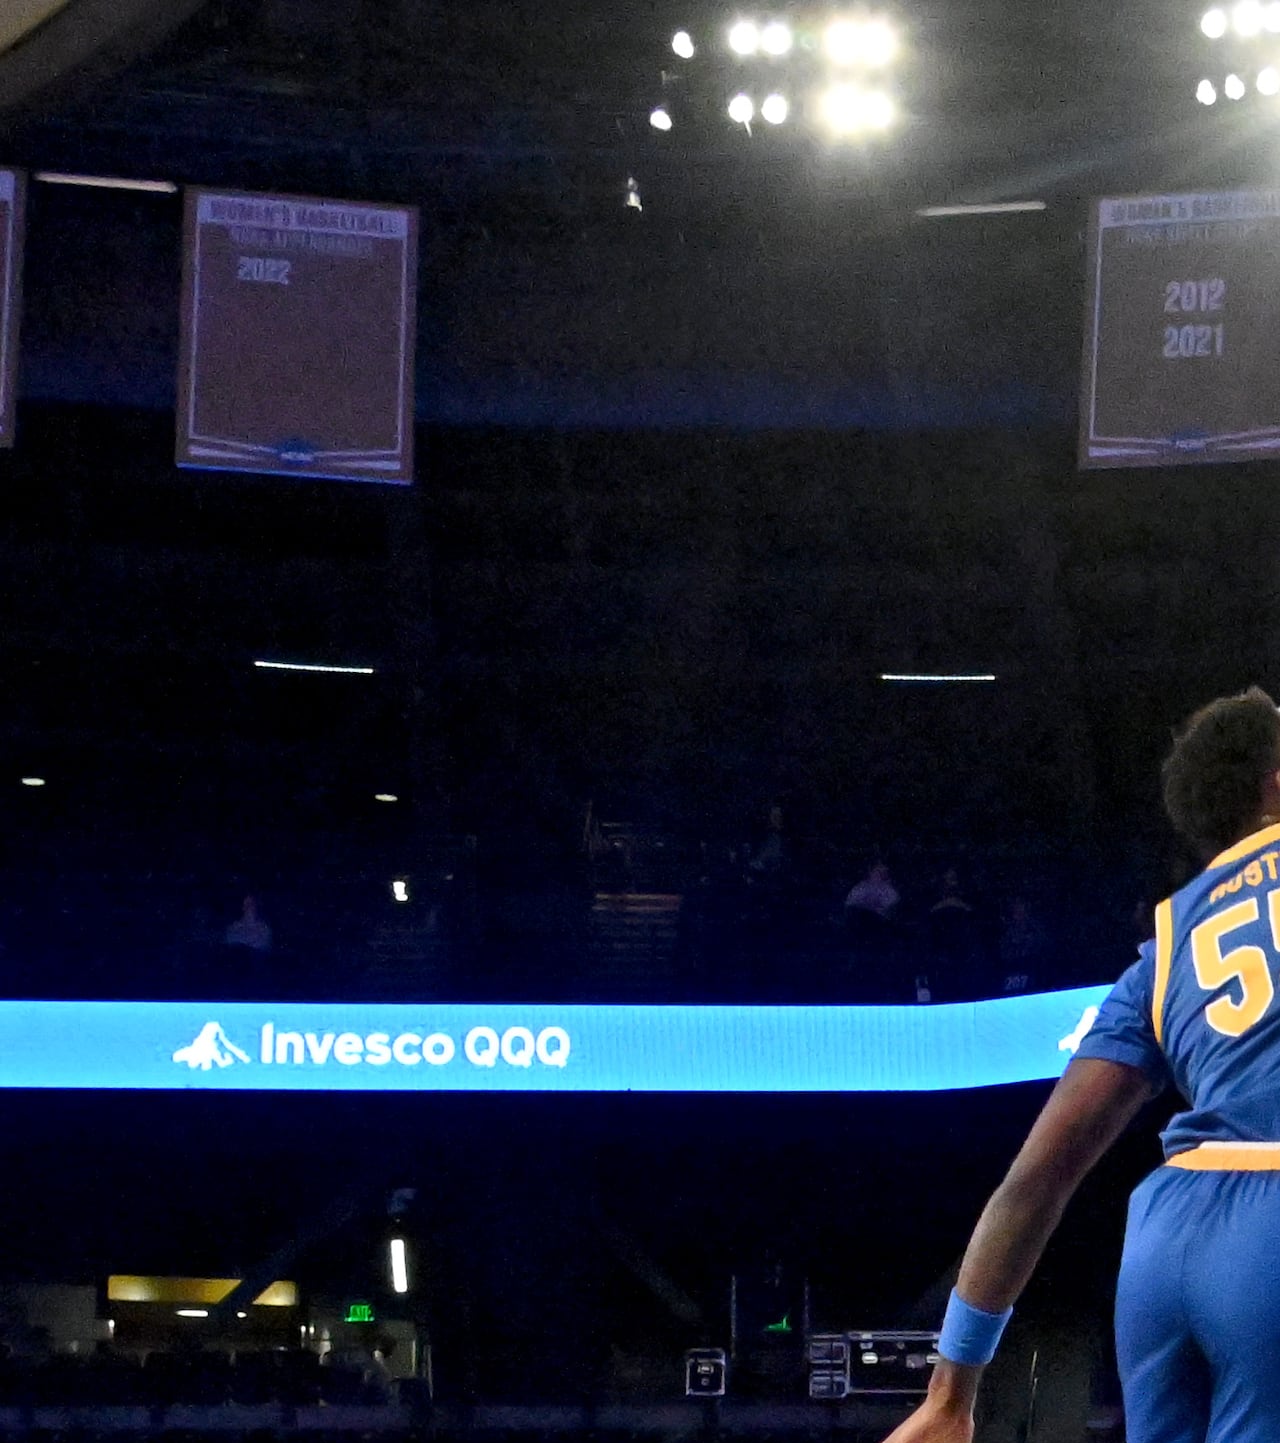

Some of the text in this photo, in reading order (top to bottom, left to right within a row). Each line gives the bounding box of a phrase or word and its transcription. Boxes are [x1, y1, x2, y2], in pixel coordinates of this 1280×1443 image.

[237, 256, 291, 285] 2022
[1164, 278, 1226, 313] 2012
[1163, 325, 1224, 358] 2021
[261, 1022, 571, 1068] Invesco QQQ
